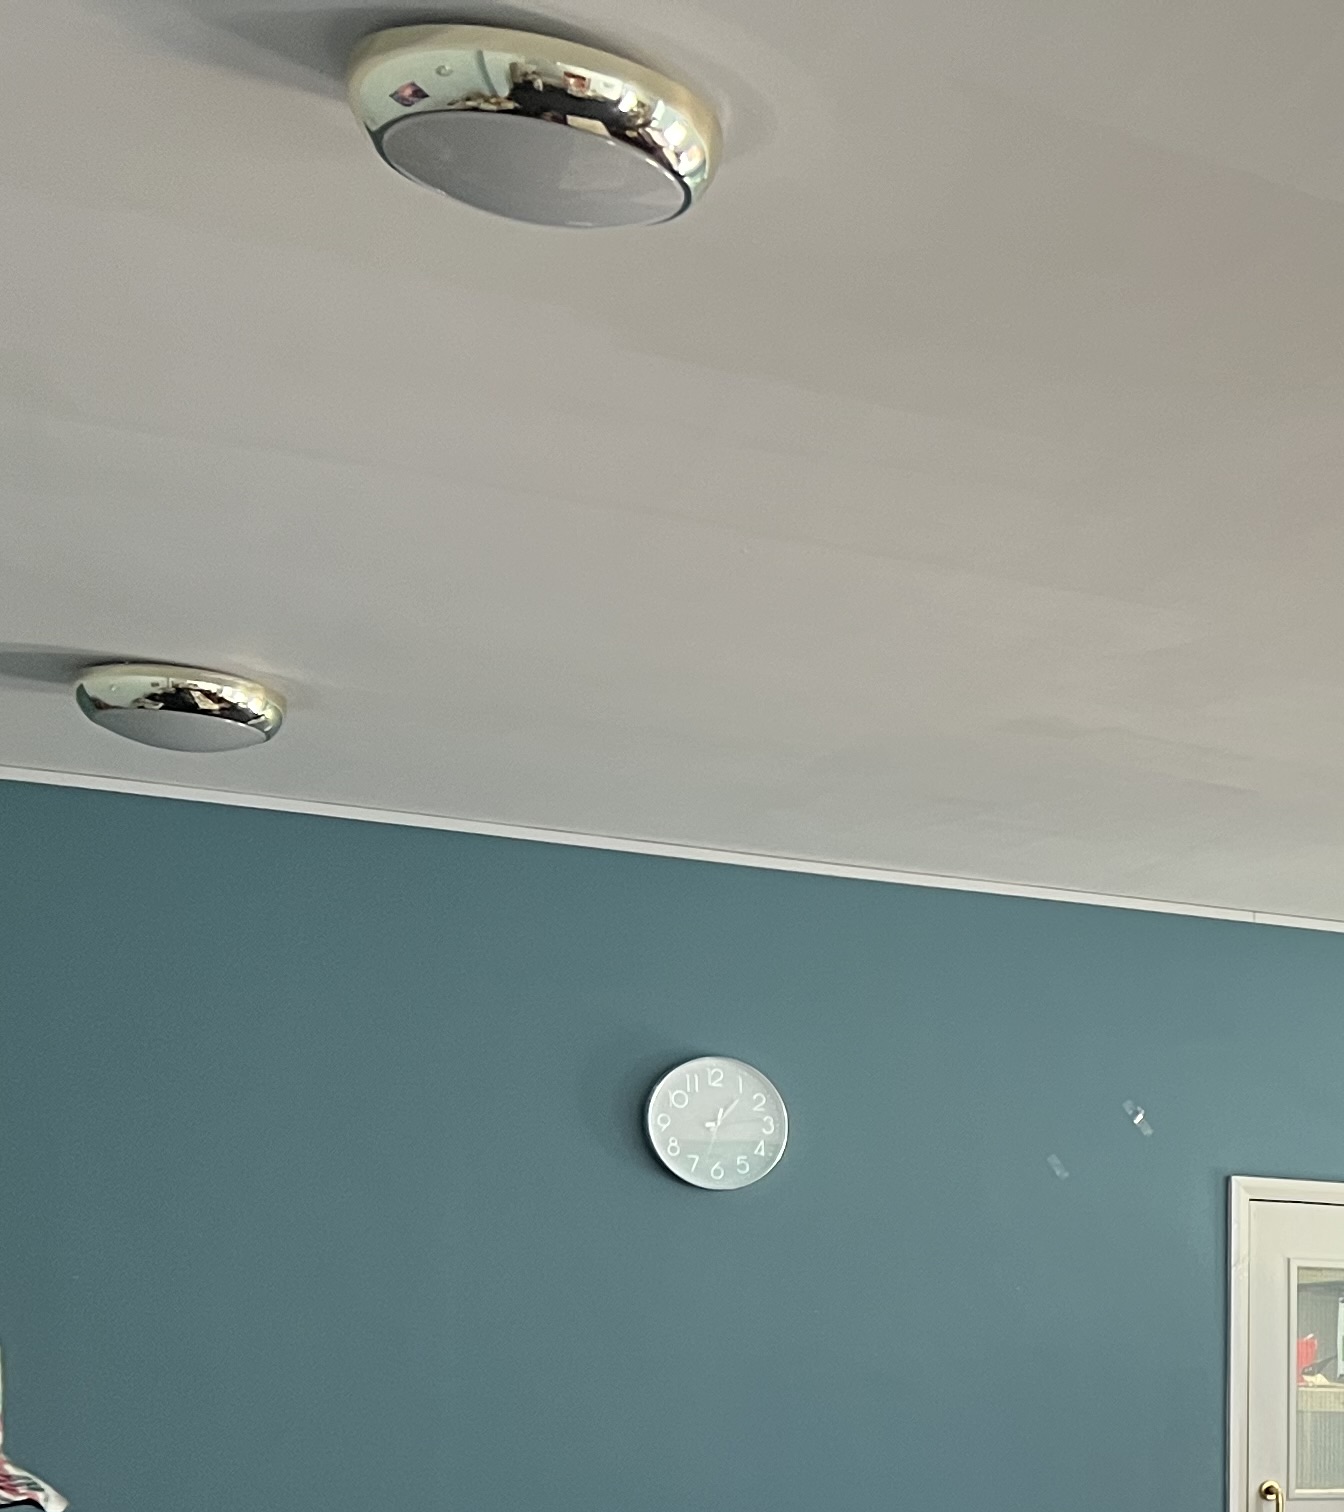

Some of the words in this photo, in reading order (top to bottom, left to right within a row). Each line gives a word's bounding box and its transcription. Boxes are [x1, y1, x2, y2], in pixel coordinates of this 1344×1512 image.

[686, 1073, 699, 1093] 11
[707, 1068, 723, 1087] 12
[738, 1075, 743, 1094] 1
[668, 1089, 689, 1109] 10
[752, 1092, 766, 1112] 2
[657, 1113, 671, 1133] 9
[762, 1115, 775, 1135] 3
[667, 1136, 681, 1157] 8
[753, 1139, 765, 1157] 4
[686, 1154, 700, 1173] 7
[710, 1160, 725, 1180] 6
[736, 1155, 750, 1174] 5
